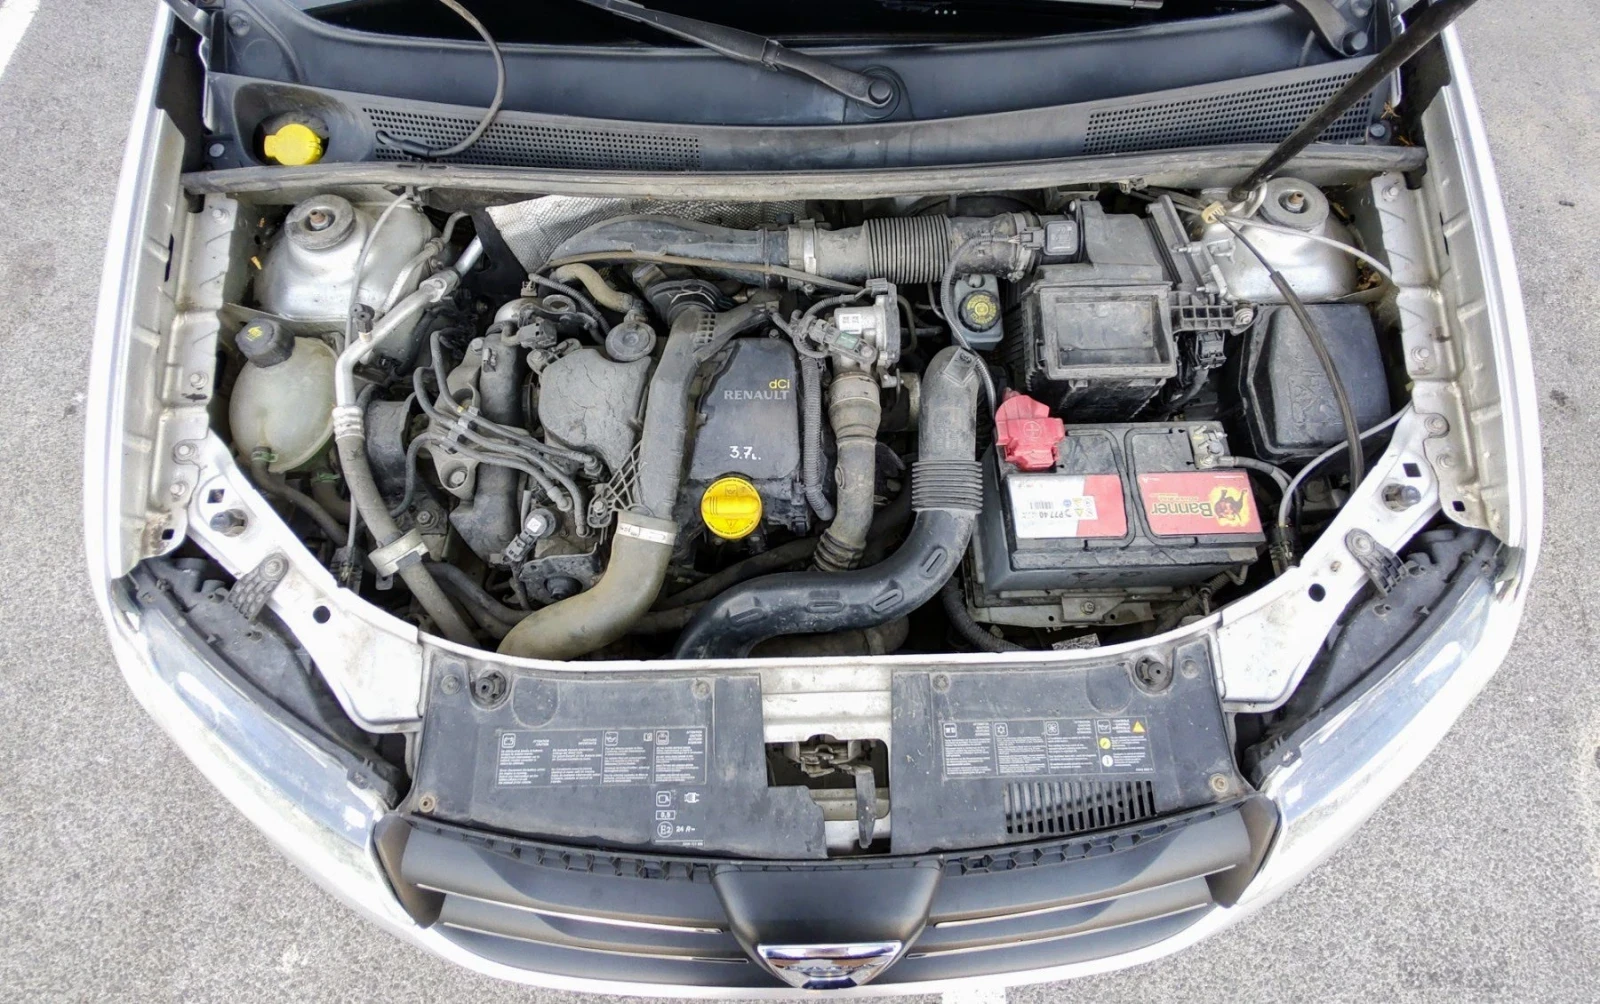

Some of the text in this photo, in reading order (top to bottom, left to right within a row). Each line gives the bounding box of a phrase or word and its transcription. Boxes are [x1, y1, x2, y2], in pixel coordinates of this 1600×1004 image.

[768, 379, 790, 389] dCi
[724, 390, 790, 400] RENAULT
[1151, 502, 1214, 517] Banner
[660, 825, 671, 835] E2
